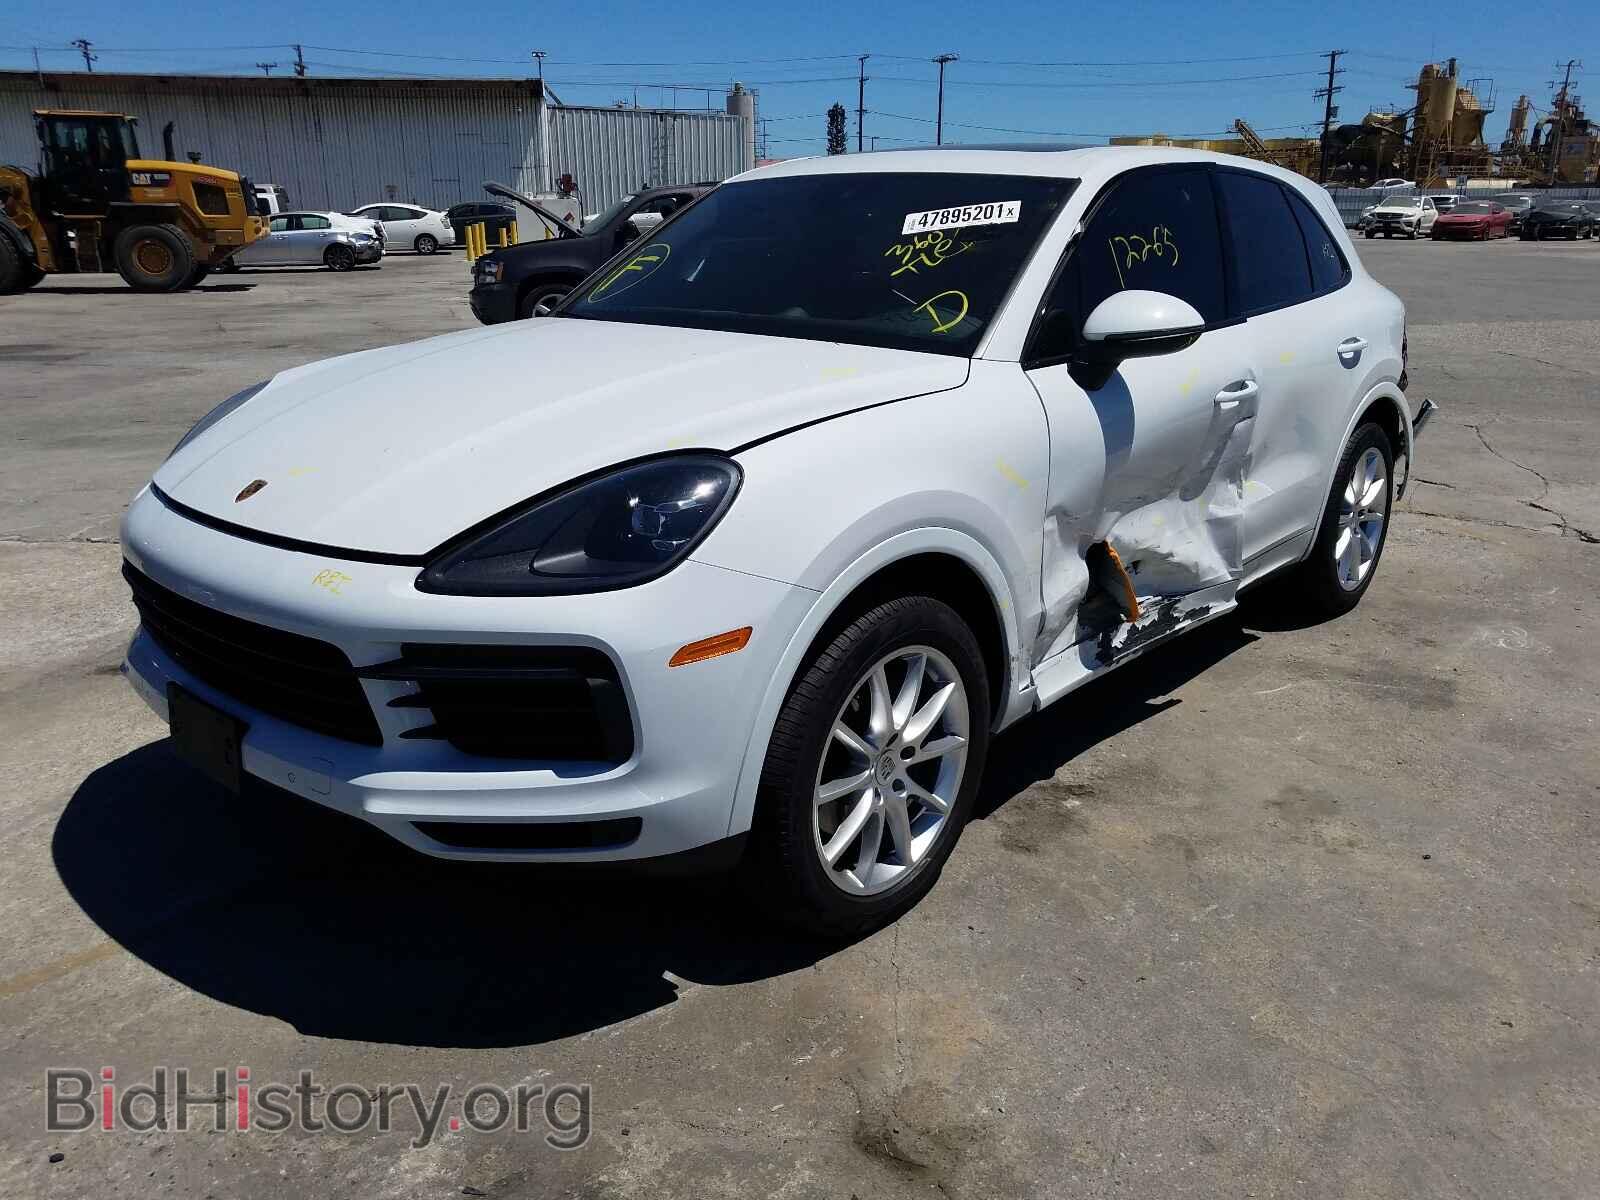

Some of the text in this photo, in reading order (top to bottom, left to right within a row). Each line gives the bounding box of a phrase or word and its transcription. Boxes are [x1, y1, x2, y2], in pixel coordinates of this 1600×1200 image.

[132, 173, 152, 185] CAT
[918, 204, 1004, 227] 47895201
[913, 290, 969, 334] D
